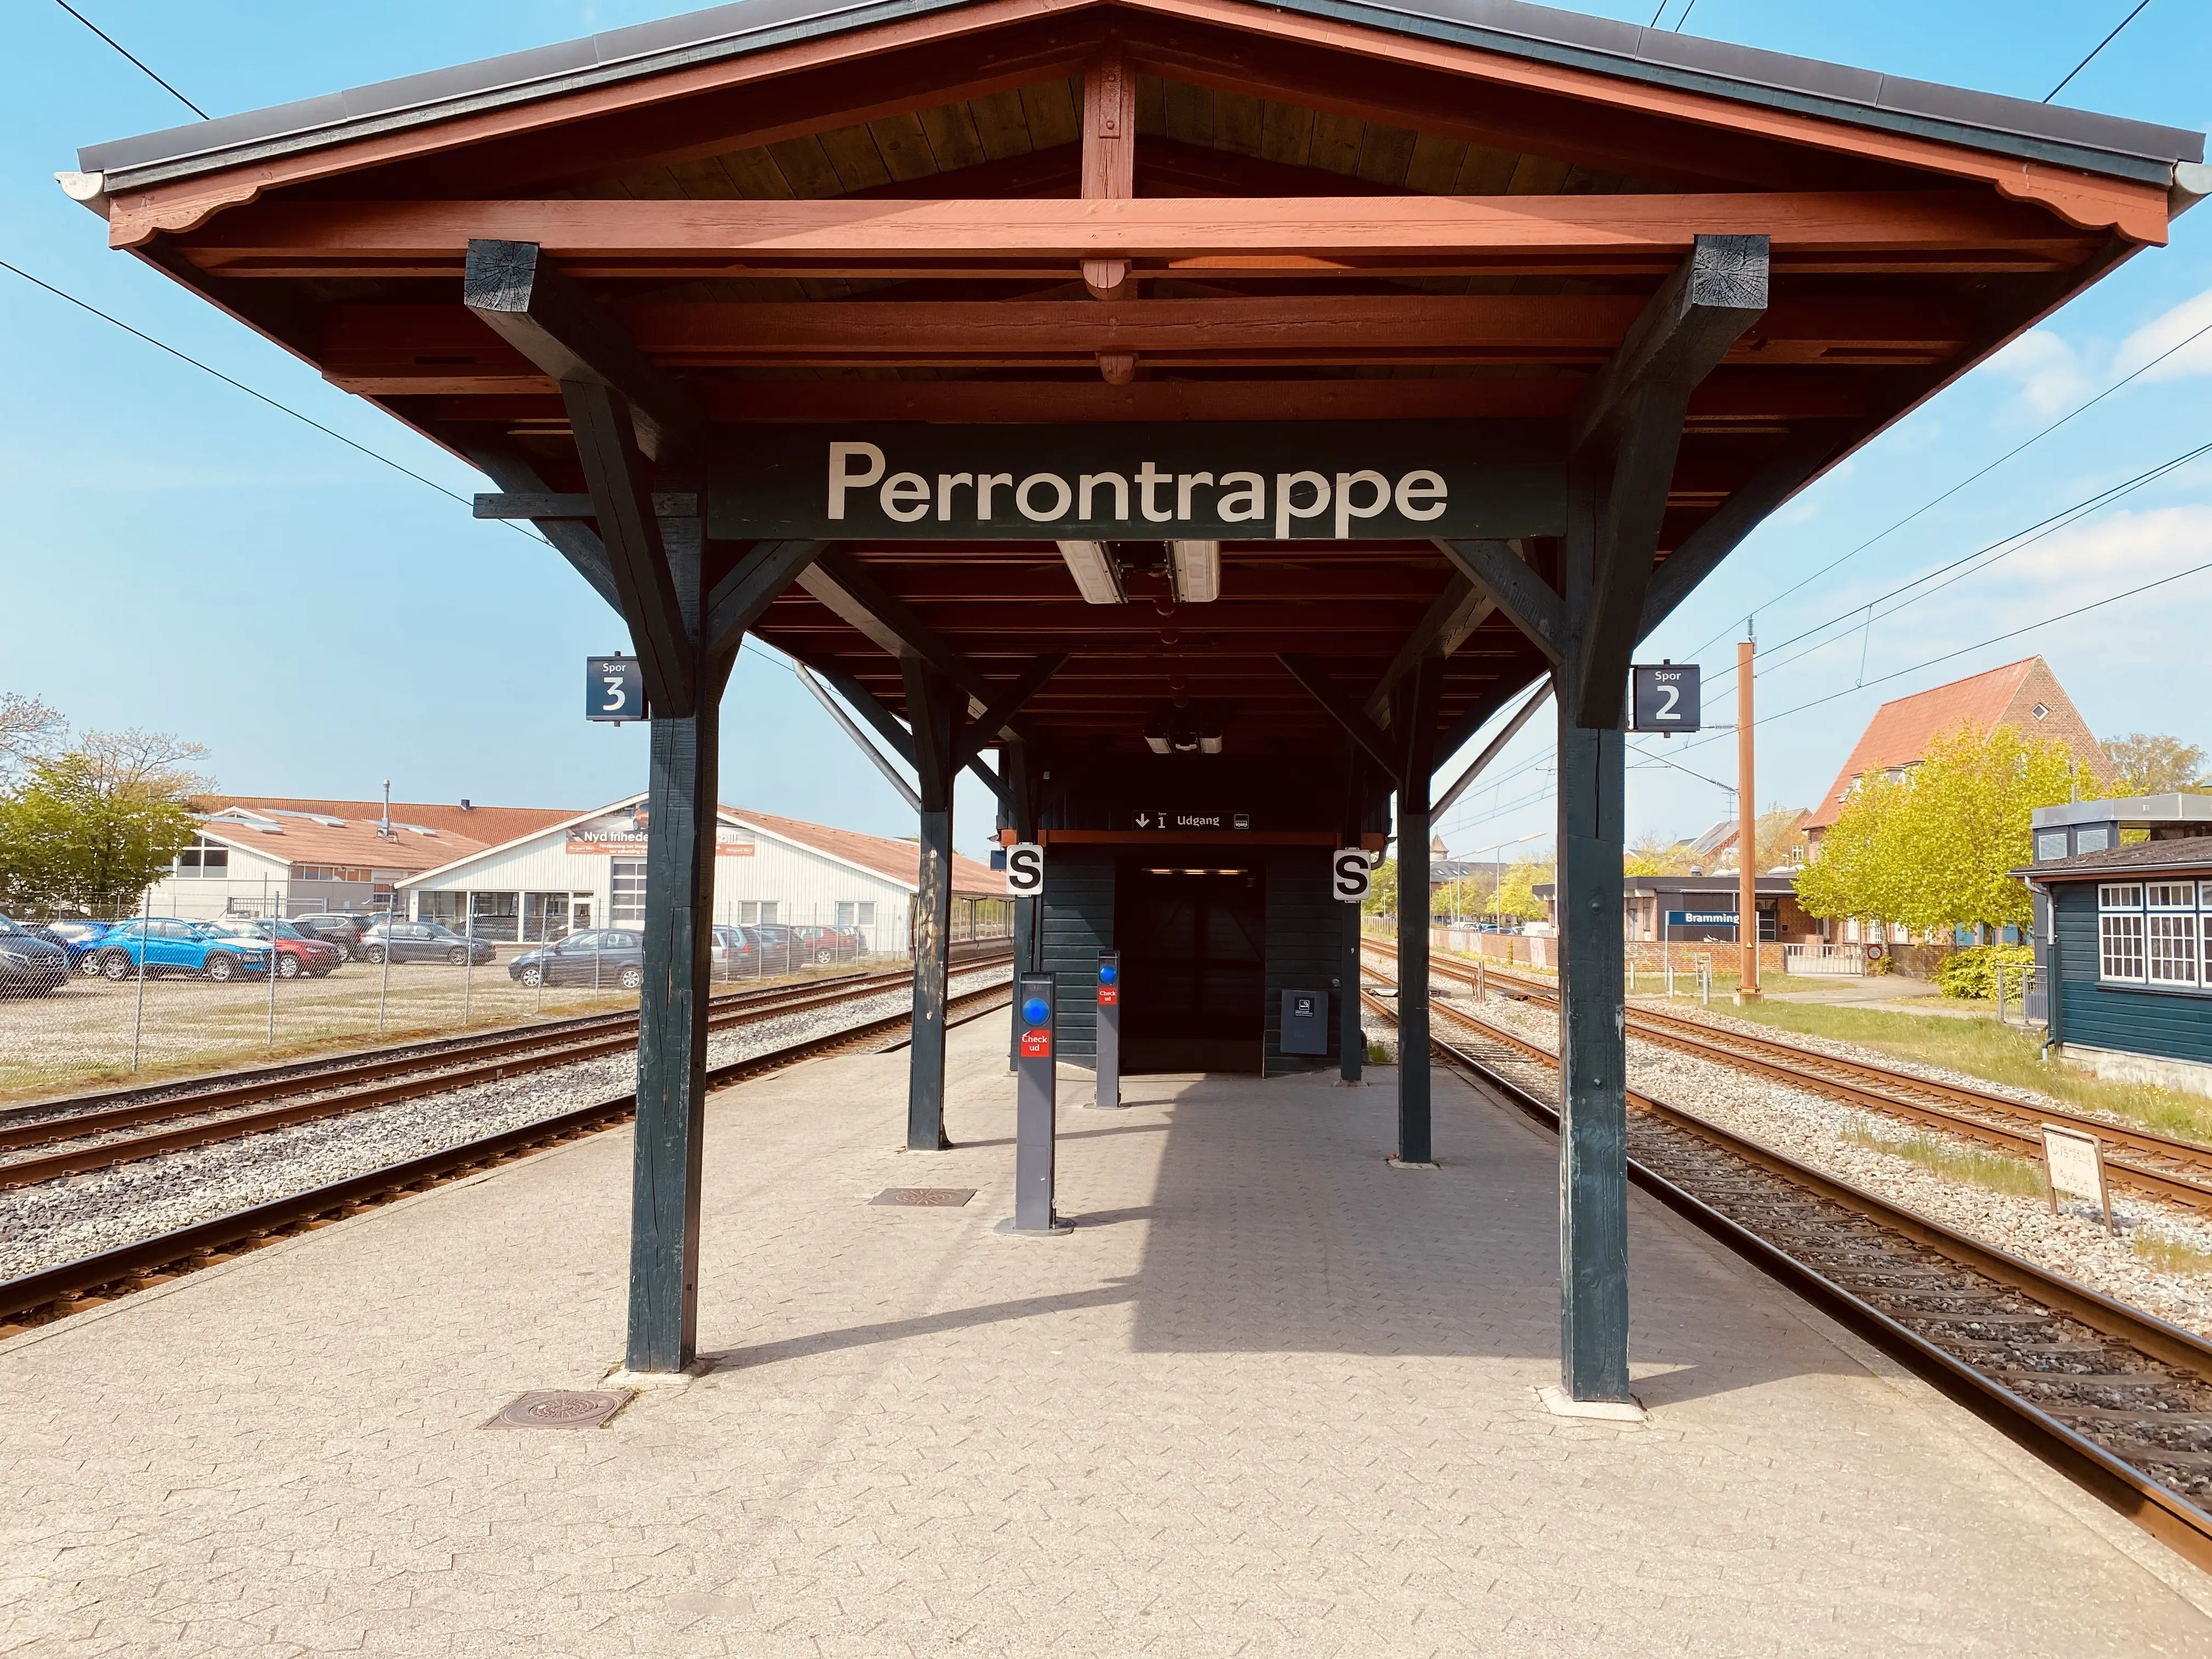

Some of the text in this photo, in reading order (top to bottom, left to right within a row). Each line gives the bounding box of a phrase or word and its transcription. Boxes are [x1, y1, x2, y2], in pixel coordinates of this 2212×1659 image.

[827, 441, 1449, 539] Perrontrappe
[602, 663, 627, 674] Spor
[1655, 671, 1681, 682] Spor
[602, 677, 625, 710] 3
[1656, 685, 1681, 720] 2
[1158, 815, 1220, 828] 1 Udgang
[584, 831, 608, 844] Nyd
[610, 831, 648, 842] frihede
[1009, 850, 1041, 889] S
[1335, 855, 1369, 895] S
[1685, 913, 1740, 924] Bramming
